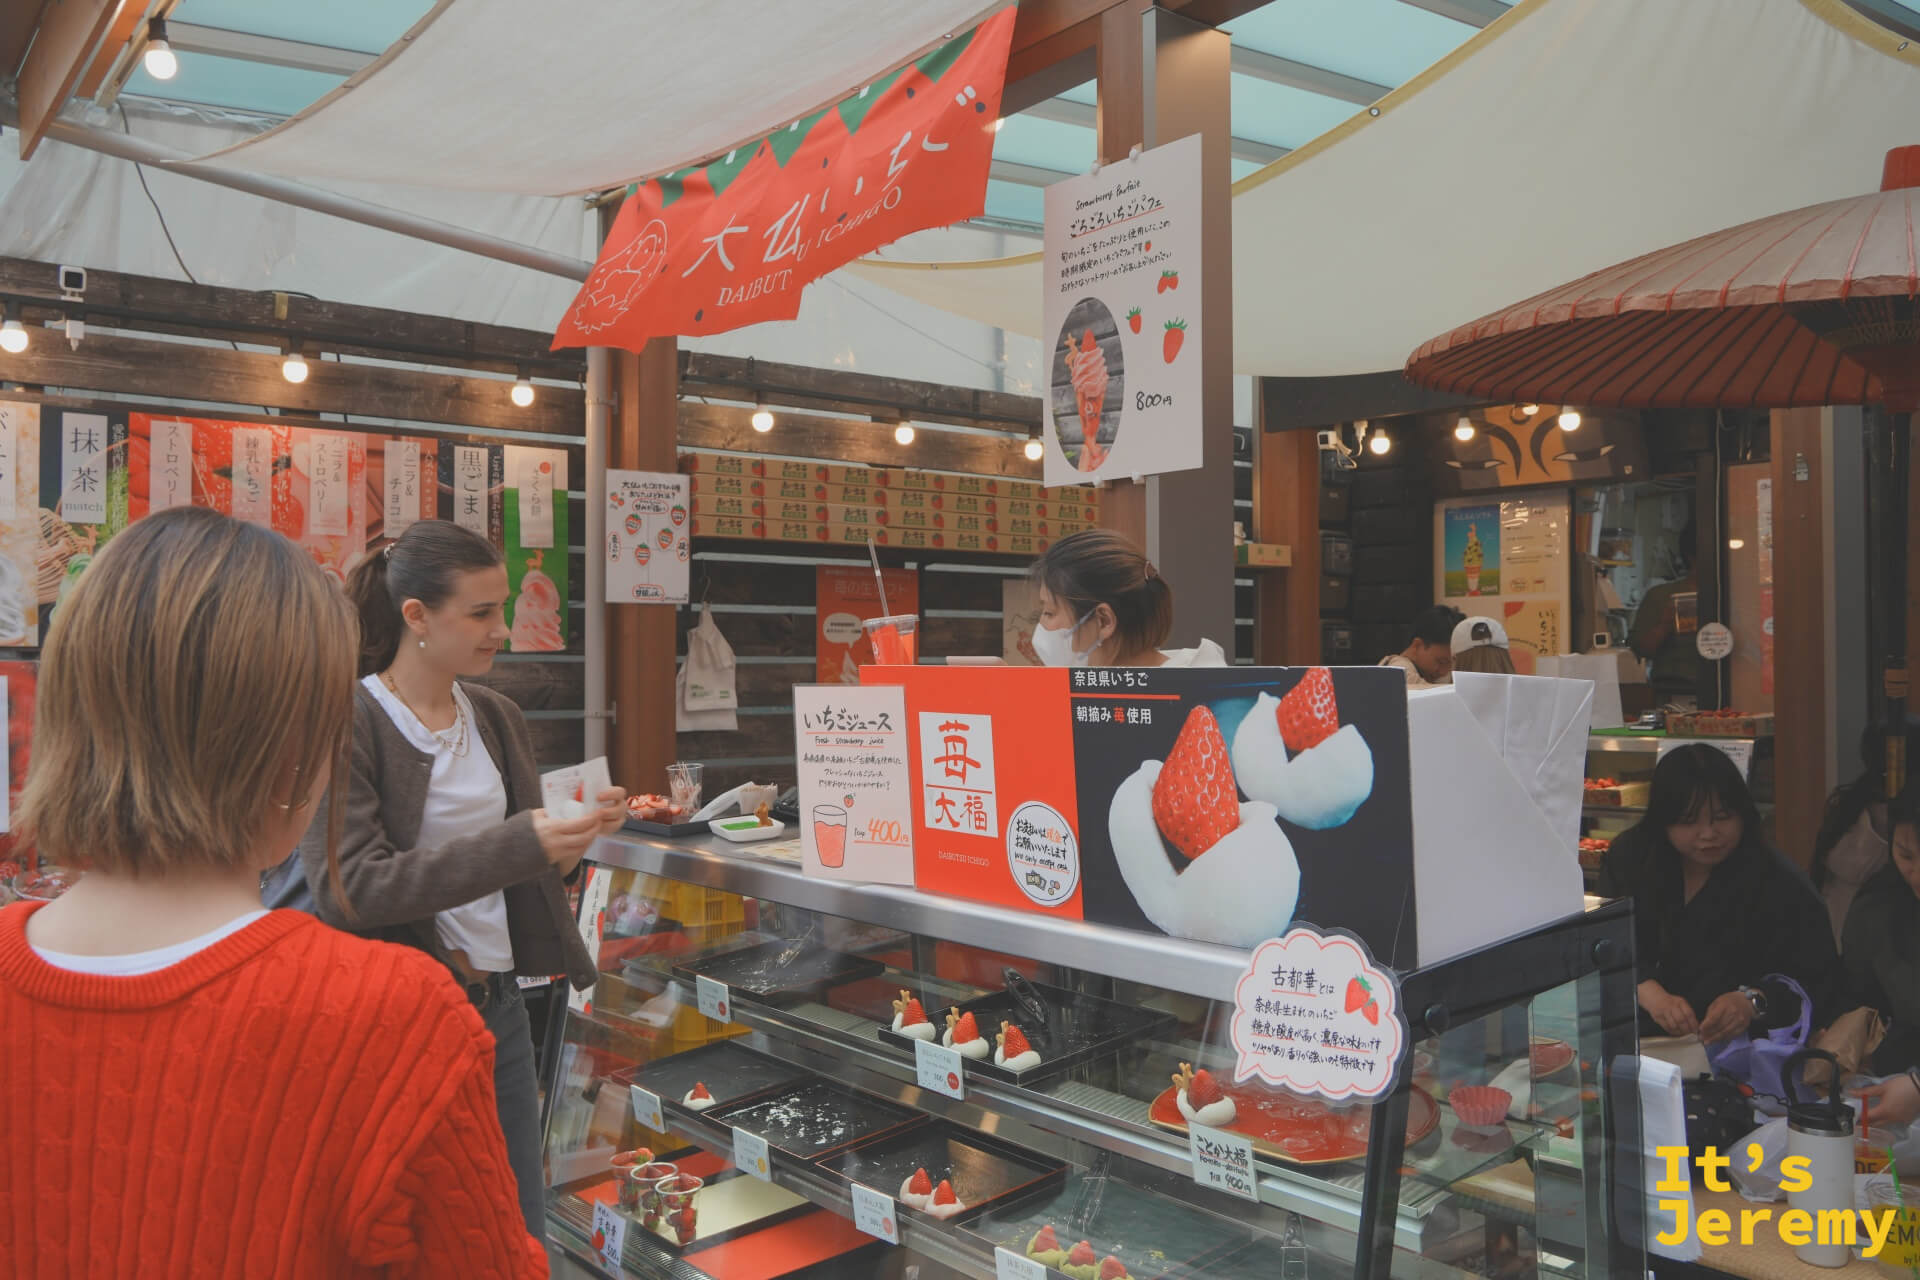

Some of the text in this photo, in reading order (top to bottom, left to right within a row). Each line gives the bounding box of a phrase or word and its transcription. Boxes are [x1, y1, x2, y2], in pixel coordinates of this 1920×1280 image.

[70, 427, 100, 493] 抹茶
[462, 450, 482, 514] 黒ごま
[1075, 670, 1149, 688] 奈良県いちご
[804, 705, 893, 732] いちごジュース
[933, 719, 982, 785] 苺
[935, 792, 989, 832] 大福
